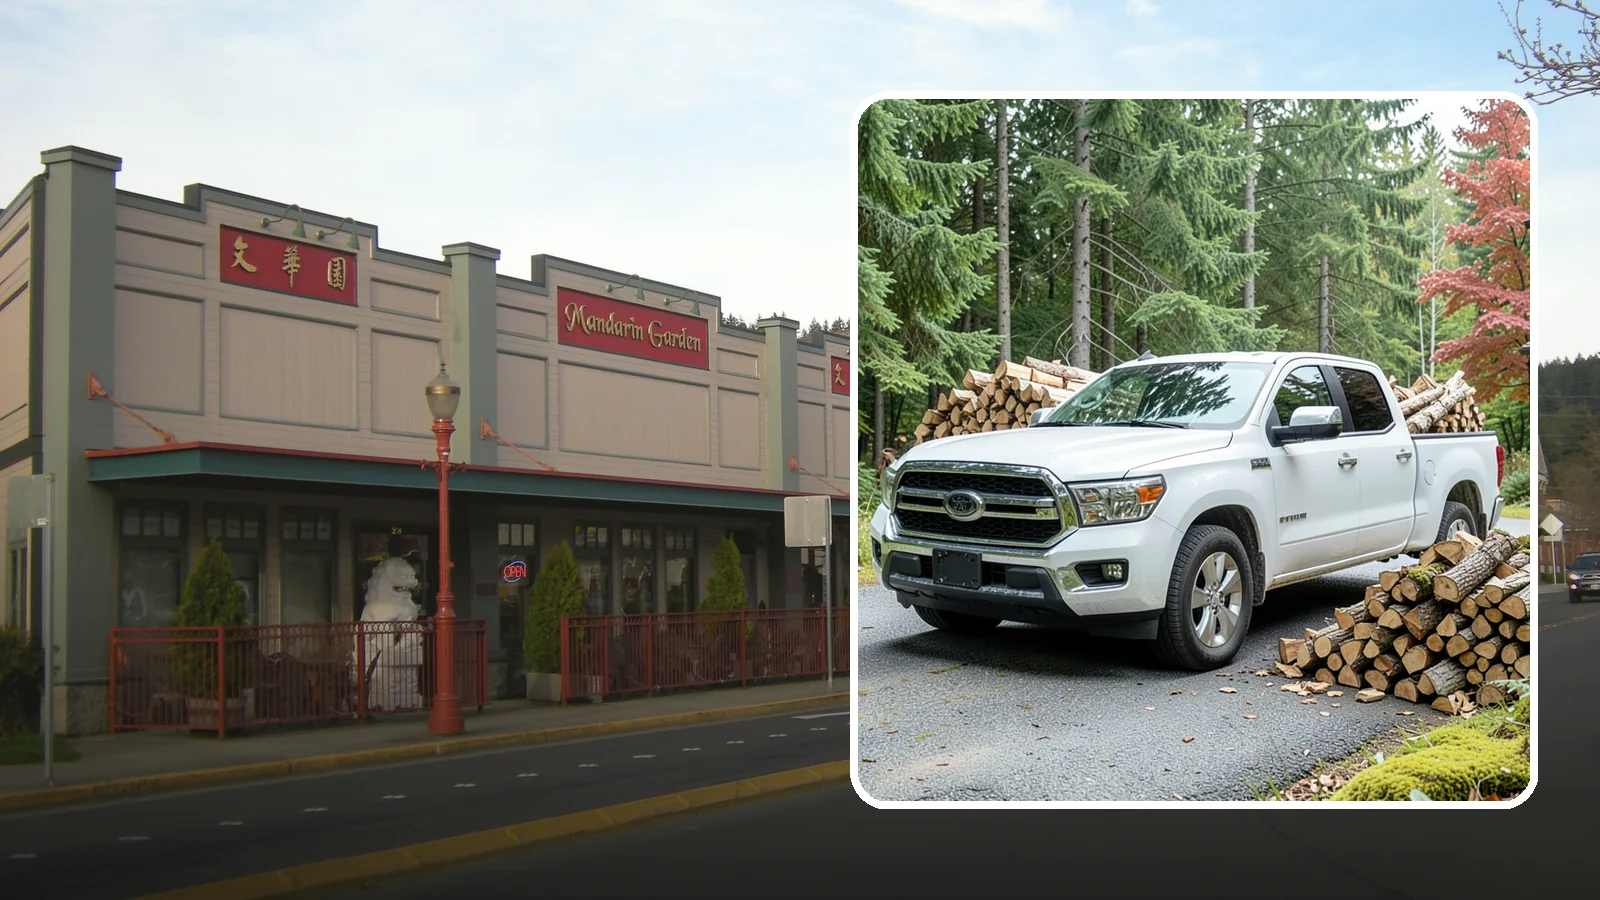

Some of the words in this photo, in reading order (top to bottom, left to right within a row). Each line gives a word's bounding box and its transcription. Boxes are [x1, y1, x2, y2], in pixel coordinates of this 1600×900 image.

[230, 235, 347, 291] 文華園
[564, 302, 643, 341] Mandarin
[647, 320, 701, 352] Garden
[834, 363, 846, 386] 文
[503, 565, 527, 578] OPEN
